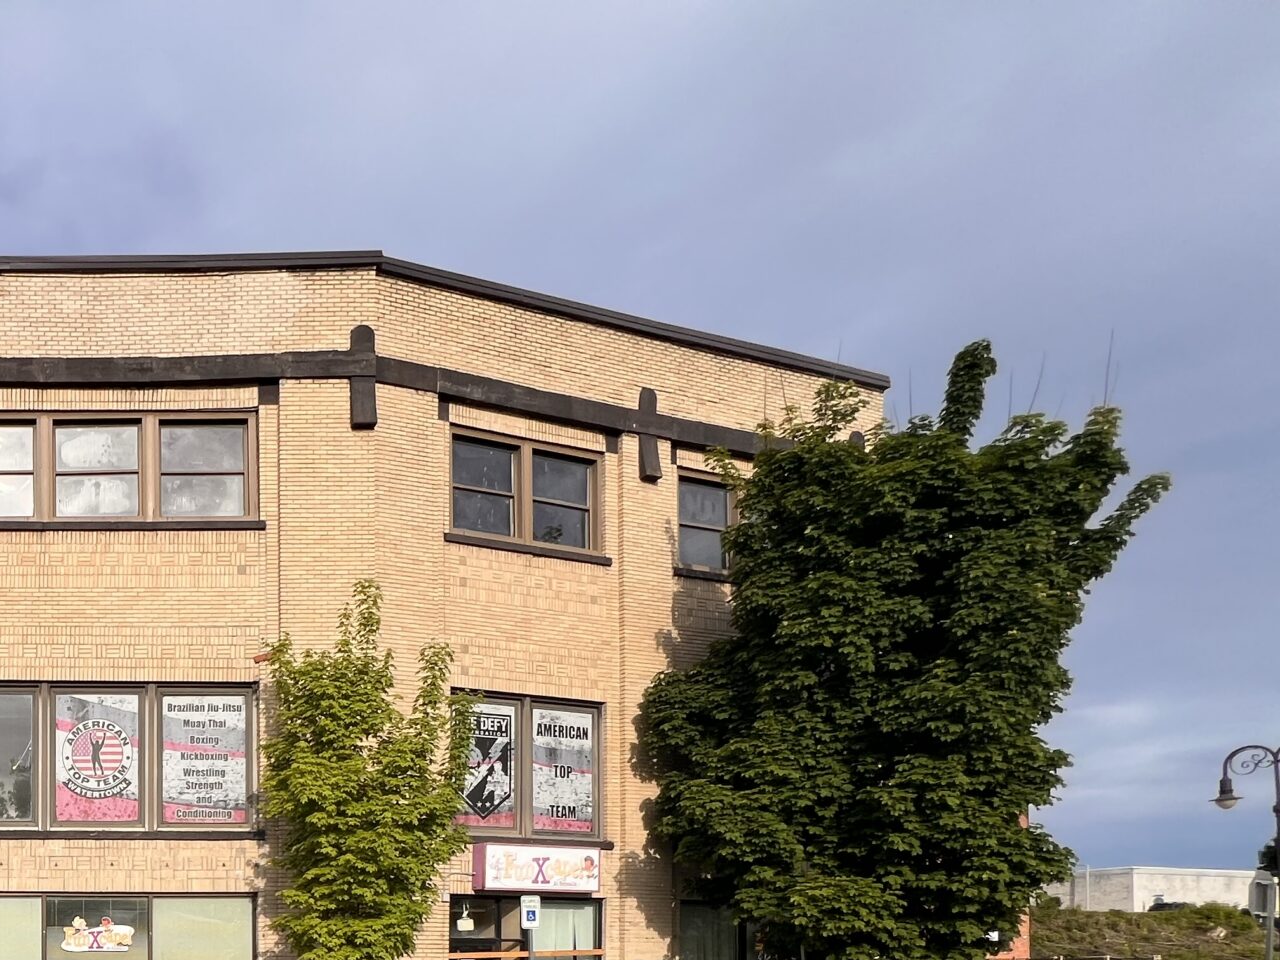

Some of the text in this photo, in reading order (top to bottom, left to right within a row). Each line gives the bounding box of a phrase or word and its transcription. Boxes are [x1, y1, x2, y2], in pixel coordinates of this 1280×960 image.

[167, 703, 242, 713] Brazilian Jiu-Jitsu
[183, 719, 226, 729] Muay Thai
[481, 718, 507, 731] DEFY
[67, 721, 129, 746] AMERICAN
[536, 723, 589, 740] AMERICAN
[189, 736, 219, 745] Boxing
[180, 752, 228, 761] Kickboxing
[68, 764, 128, 787] TOP TEAM
[183, 768, 225, 778] Wrestling
[553, 765, 572, 778] TOP
[66, 781, 127, 798] WATERTOWN
[185, 781, 223, 790] Strength
[195, 795, 213, 804] and
[176, 809, 232, 819] Conditioning
[549, 805, 576, 818] TEAM
